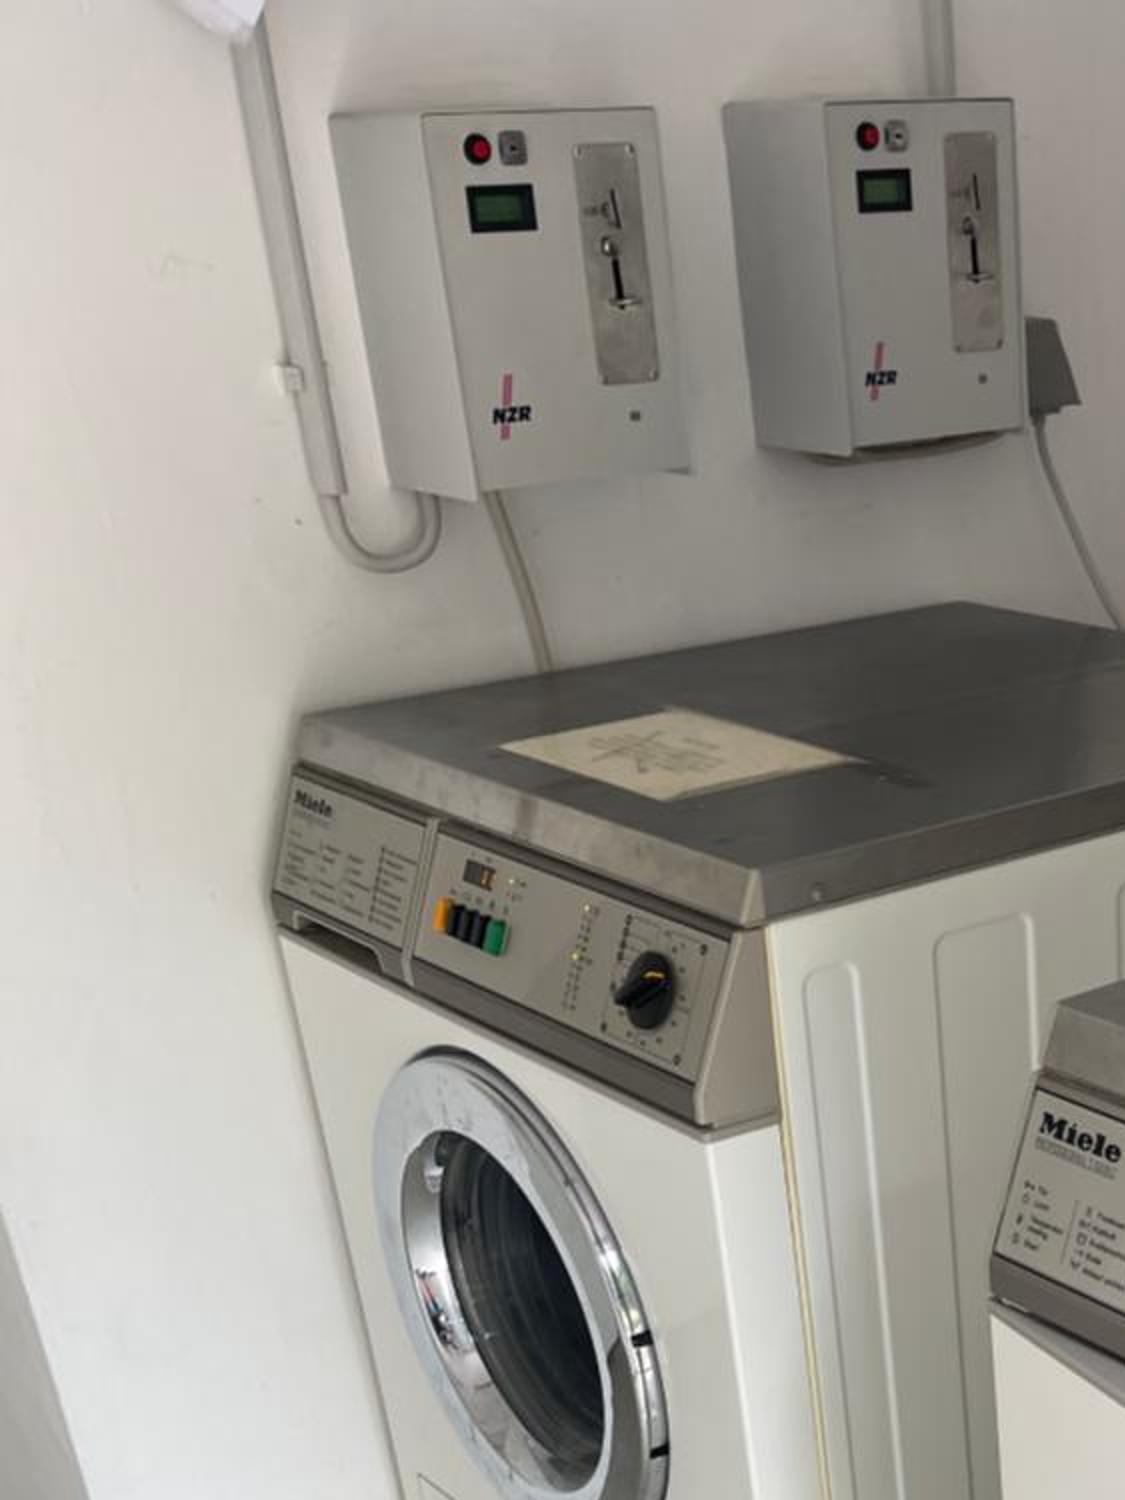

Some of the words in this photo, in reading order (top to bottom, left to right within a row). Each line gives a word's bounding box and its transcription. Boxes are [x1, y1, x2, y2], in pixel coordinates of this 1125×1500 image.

[865, 370, 897, 387] NZR
[493, 406, 531, 424] NZR
[294, 790, 332, 817] Miele
[1039, 1111, 1121, 1163] Miele
